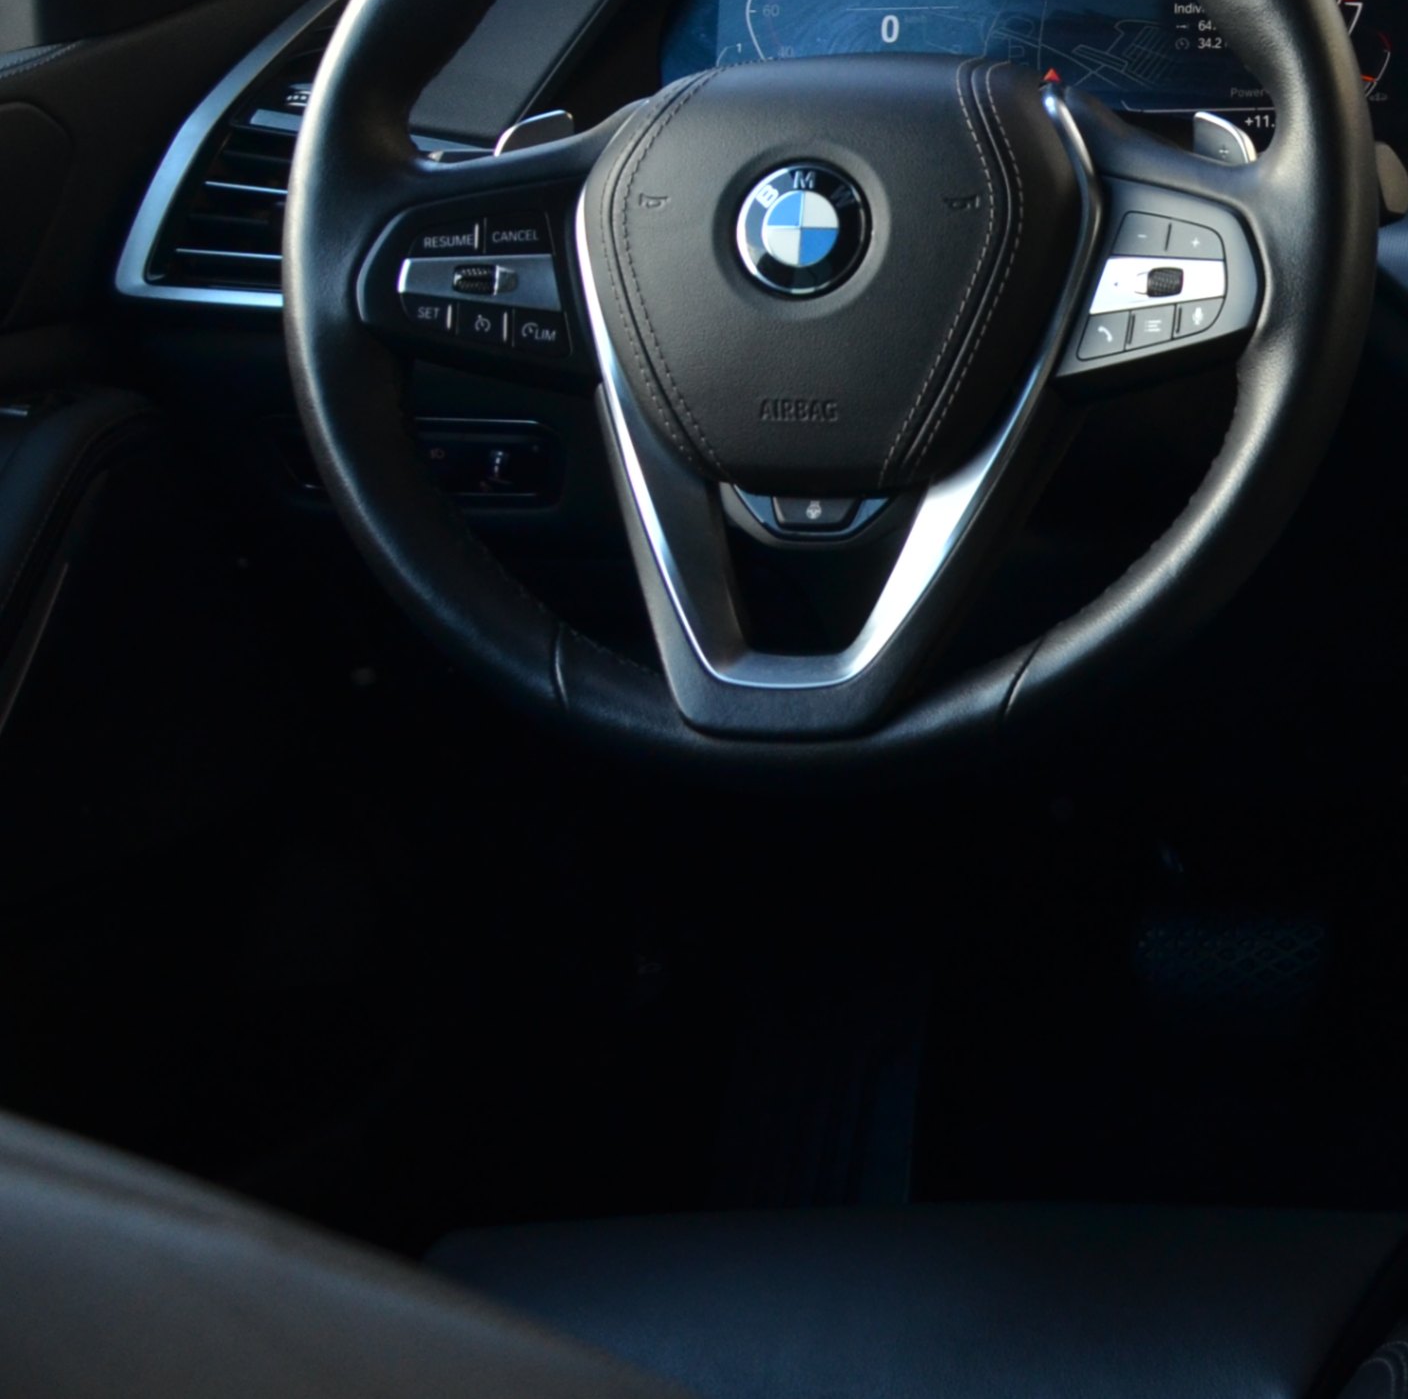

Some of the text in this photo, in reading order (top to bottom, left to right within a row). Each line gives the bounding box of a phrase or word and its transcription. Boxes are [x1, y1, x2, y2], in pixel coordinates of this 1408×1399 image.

[763, 5, 780, 17] 60
[881, 15, 900, 43] 0
[1198, 38, 1222, 49] 34.2
[756, 169, 855, 210] BMW
[423, 233, 474, 248] RESUME
[491, 229, 539, 242] CANCEL
[417, 306, 440, 319] SET
[534, 328, 556, 342] LIM
[760, 399, 839, 422] AIRBAG
